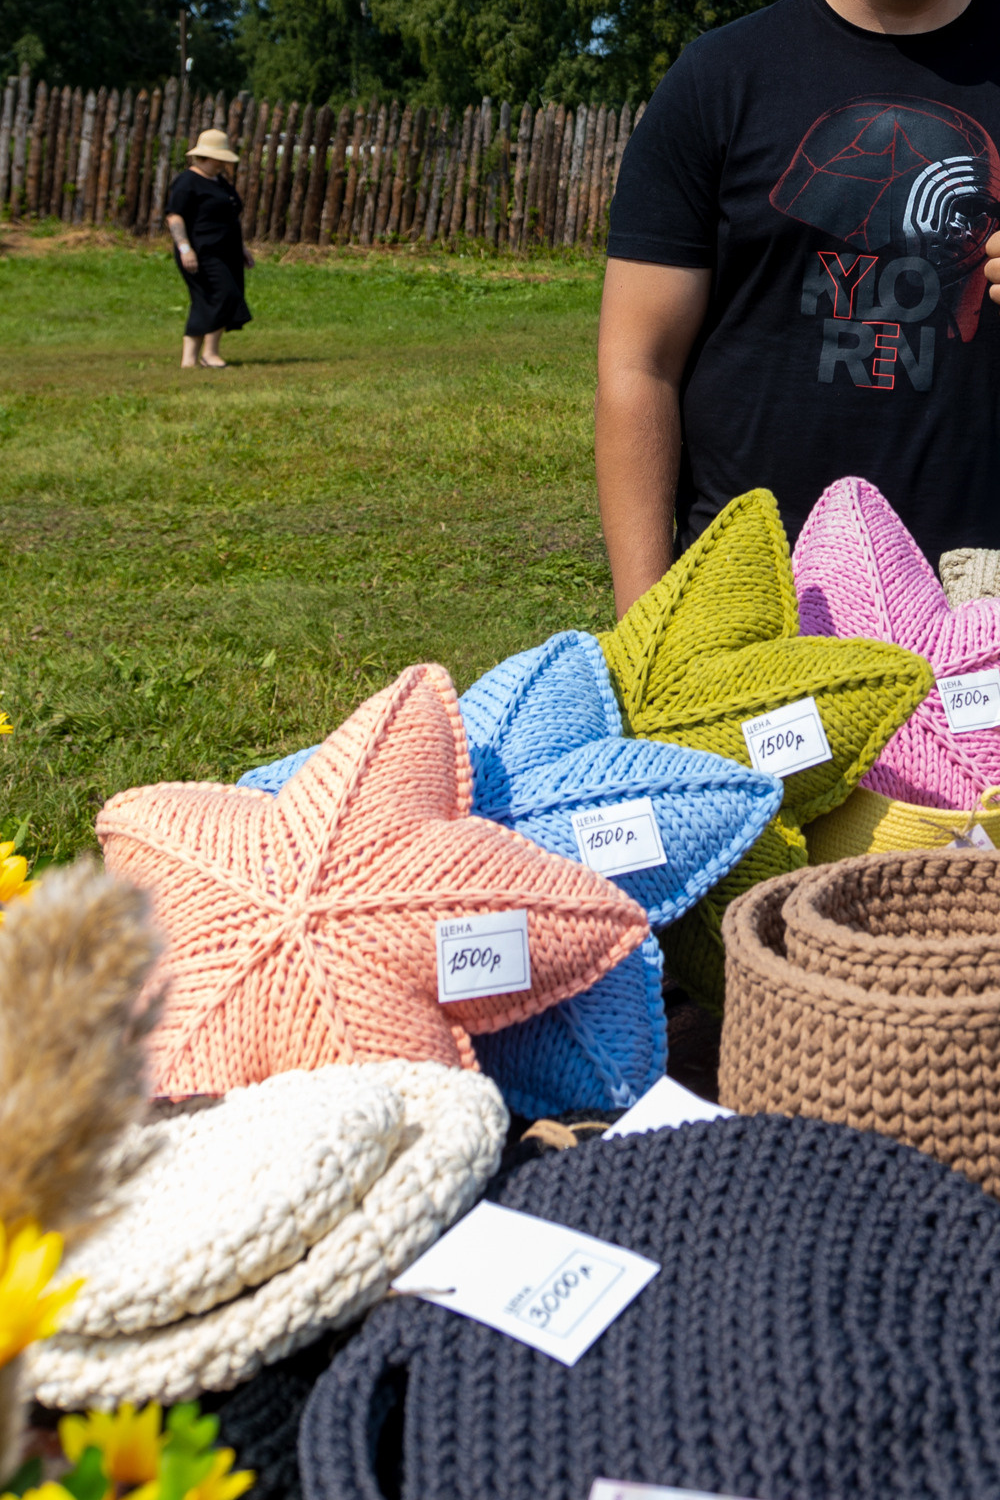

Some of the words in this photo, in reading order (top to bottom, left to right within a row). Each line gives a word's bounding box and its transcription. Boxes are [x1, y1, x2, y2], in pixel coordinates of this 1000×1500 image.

[801, 251, 940, 323] KYLO
[817, 318, 936, 392] REN
[940, 680, 963, 690] ЦЕНА
[746, 719, 771, 735] ЦЕНА
[576, 814, 604, 827] ЦЕНА
[440, 923, 473, 938] ЦЕНА
